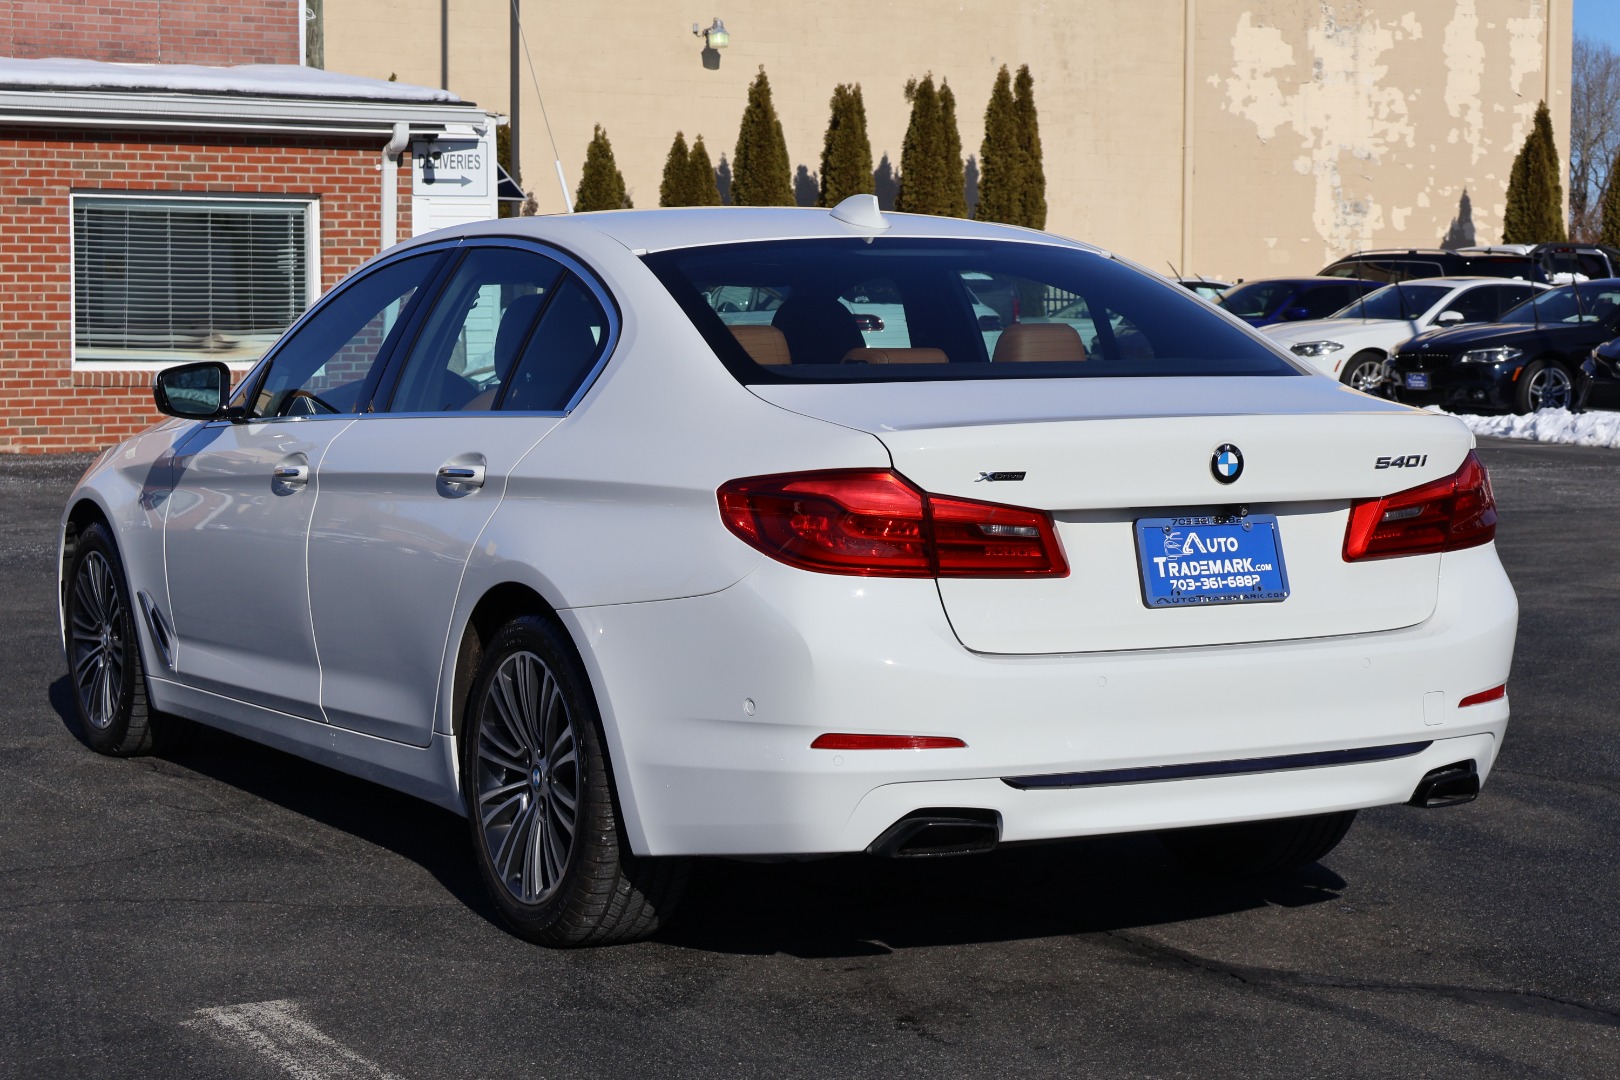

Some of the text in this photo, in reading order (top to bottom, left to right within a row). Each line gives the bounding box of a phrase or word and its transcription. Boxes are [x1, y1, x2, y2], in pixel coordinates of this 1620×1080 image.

[418, 153, 481, 170] DELIVERIES
[1374, 454, 1428, 470] 540i
[1182, 532, 1239, 554] AUTO
